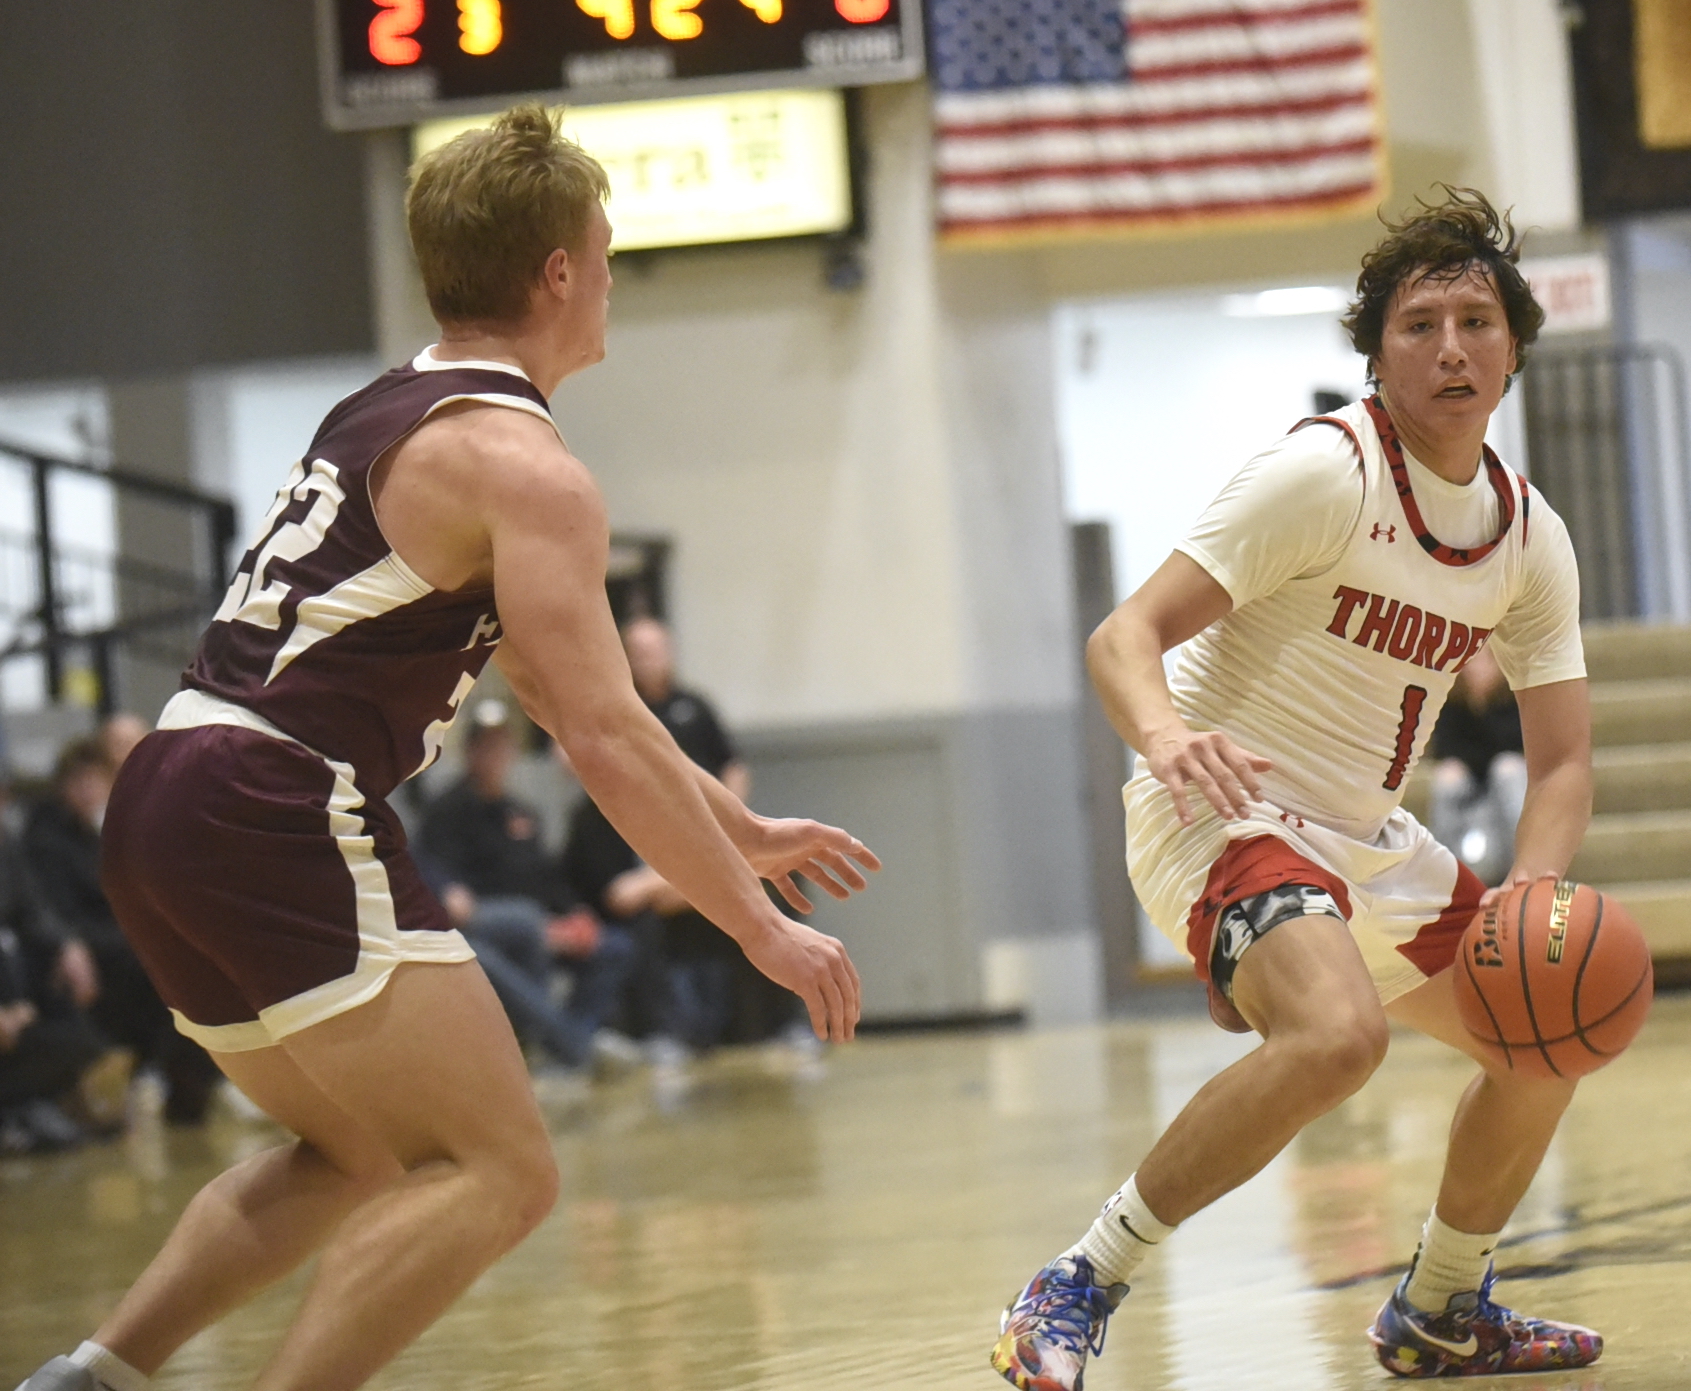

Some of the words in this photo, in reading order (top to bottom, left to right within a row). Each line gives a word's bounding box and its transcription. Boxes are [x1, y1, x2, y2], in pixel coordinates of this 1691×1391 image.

[1325, 584, 1495, 674] THORPE
[1382, 684, 1428, 792] 1
[1546, 884, 1576, 965] ELITE
